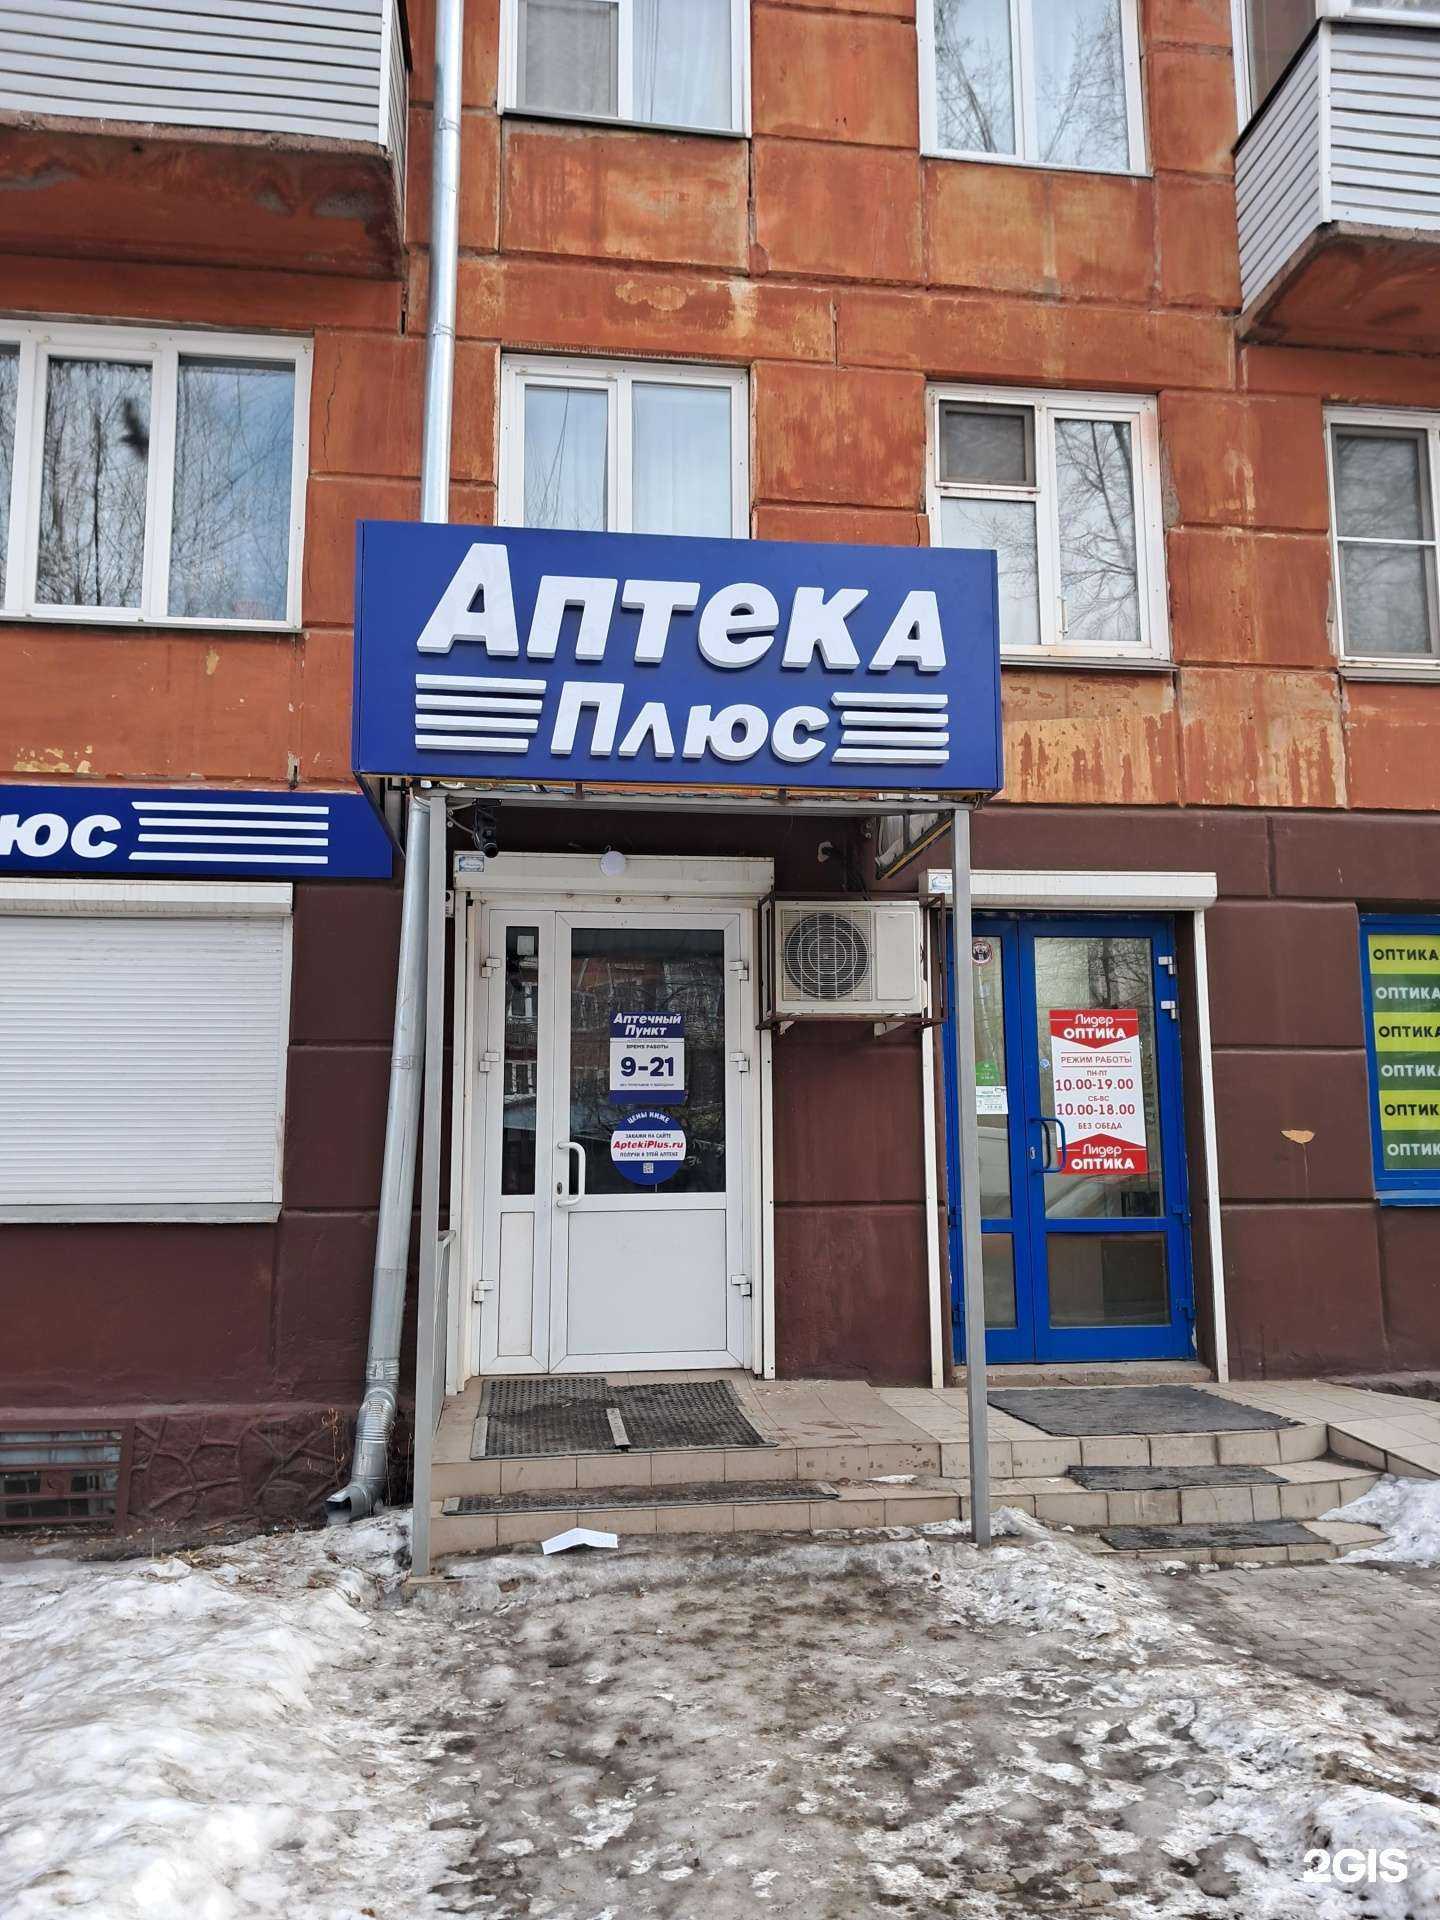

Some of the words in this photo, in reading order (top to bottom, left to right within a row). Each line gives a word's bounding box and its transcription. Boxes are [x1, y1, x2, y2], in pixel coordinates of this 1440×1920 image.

[550, 681, 829, 762] Плюс
[1373, 948, 1440, 961] ОПТИКА
[1375, 986, 1440, 1000] ОПТИКА
[613, 1012, 682, 1024] Аптечный
[1075, 1013, 1114, 1028] Лидер
[624, 1024, 667, 1038] Пункт
[1063, 1027, 1127, 1040] ОПТИКА
[620, 1056, 674, 1077] 9-21
[1061, 1056, 1093, 1064] РЕЖИМ
[1095, 1056, 1133, 1064] РАБОТЫ
[1381, 1064, 1440, 1077] ОПТИК
[1056, 1078, 1134, 1091] 10.00-19.00
[1056, 1103, 1136, 1116] 10.00-18.00
[1078, 1122, 1092, 1130] БЕЗ
[1095, 1122, 1123, 1130] ОБЕДА
[613, 1140, 684, 1150] AptekiPlus.ru
[1082, 1143, 1122, 1158] Лидер
[1071, 1158, 1135, 1170] ОПТИКА
